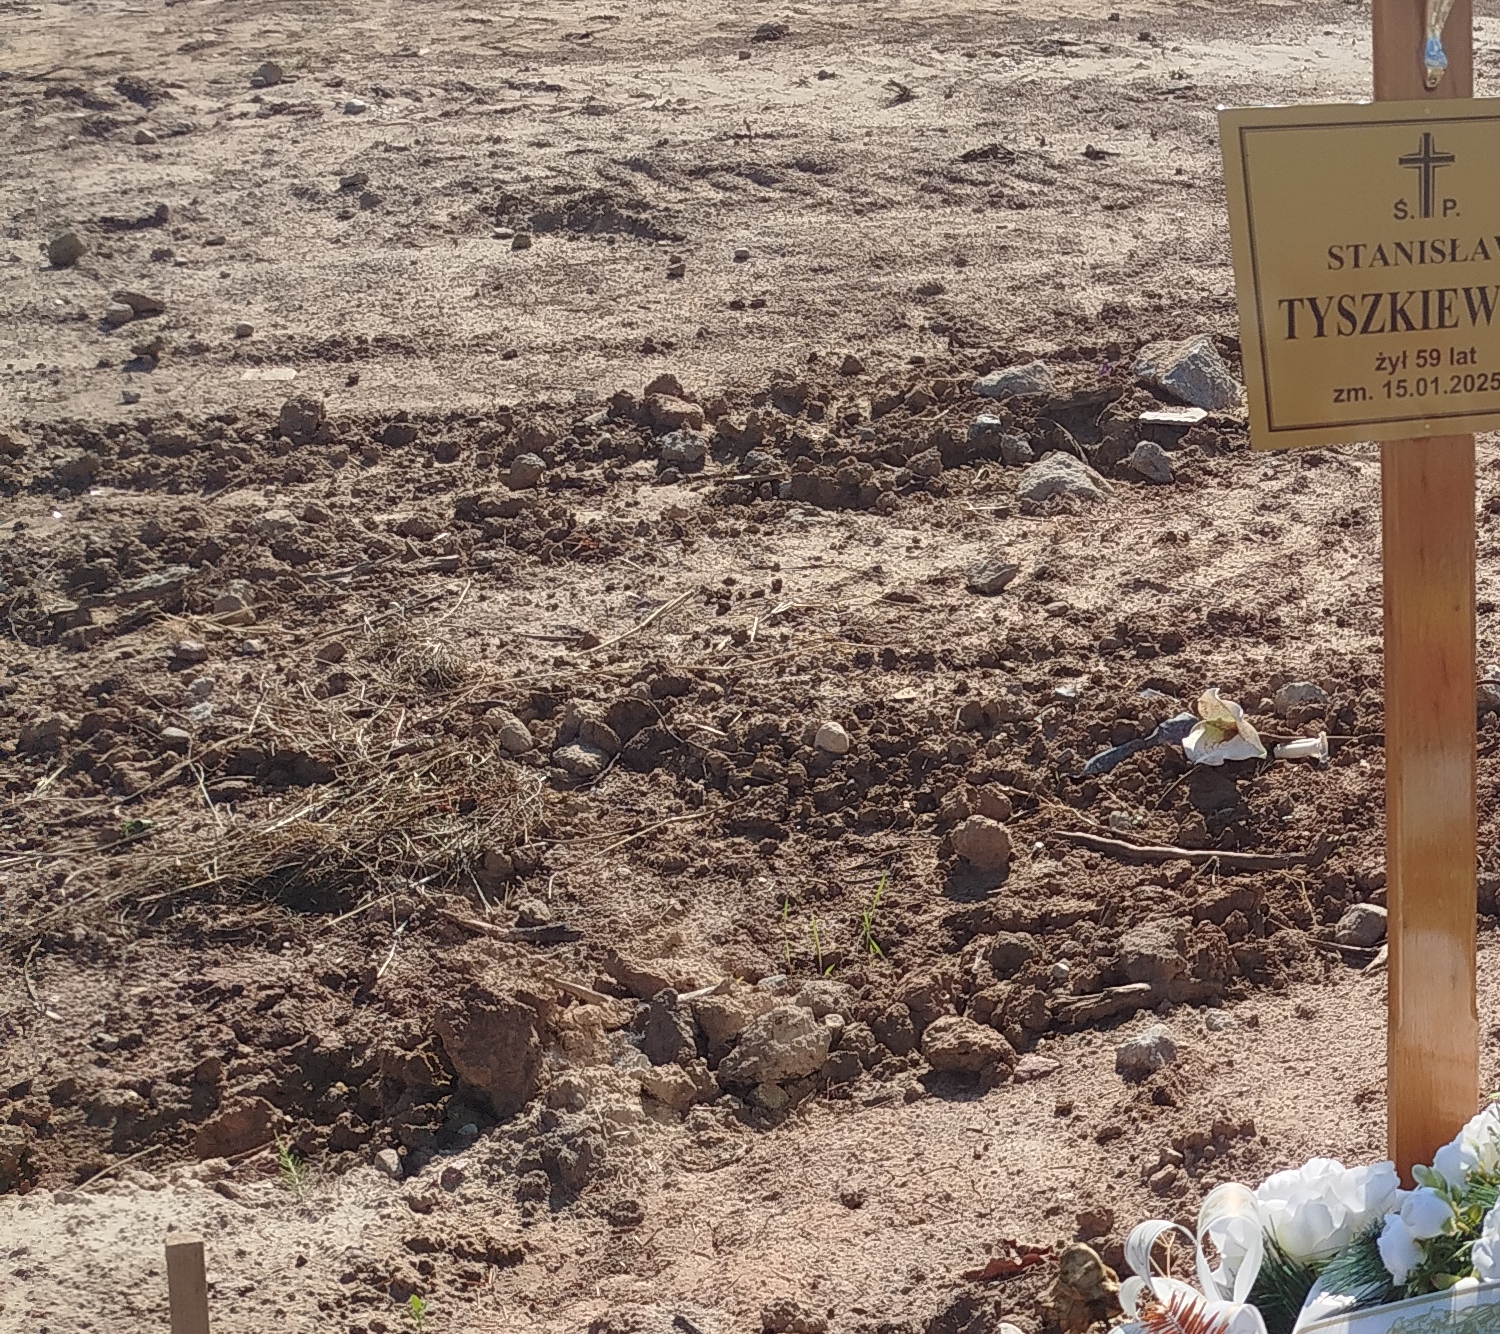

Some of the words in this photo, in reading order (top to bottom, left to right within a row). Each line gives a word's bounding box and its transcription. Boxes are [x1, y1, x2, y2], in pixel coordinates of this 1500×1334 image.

[1442, 198, 1461, 218] P.
[1374, 350, 1408, 375] żył
[1415, 347, 1442, 368] 59
[1449, 345, 1477, 366] lat
[1333, 386, 1374, 404] zm.
